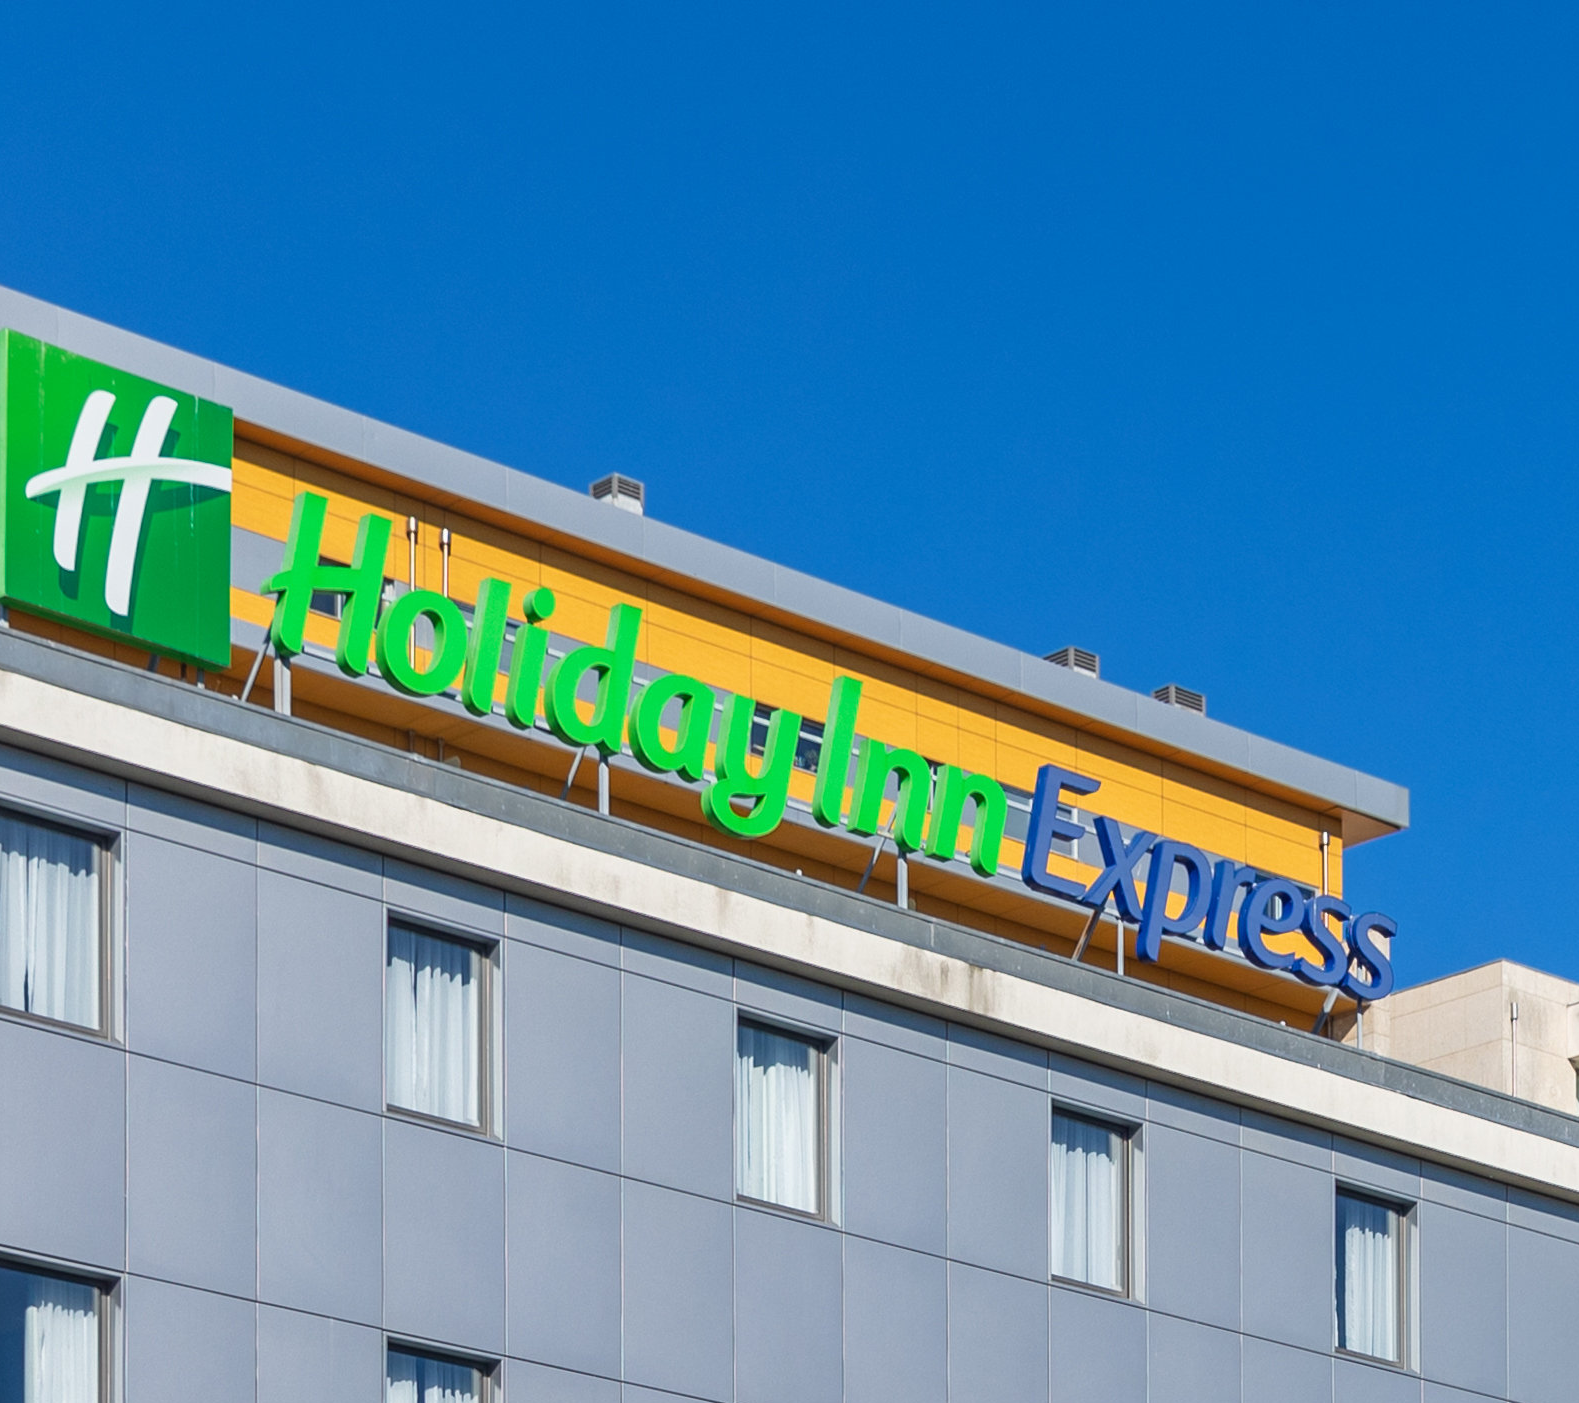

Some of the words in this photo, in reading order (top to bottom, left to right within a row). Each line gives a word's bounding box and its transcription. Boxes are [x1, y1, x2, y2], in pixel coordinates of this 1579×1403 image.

[260, 490, 803, 838] Holiday
[811, 675, 1008, 877] Inn
[1021, 763, 1398, 1001] Express
